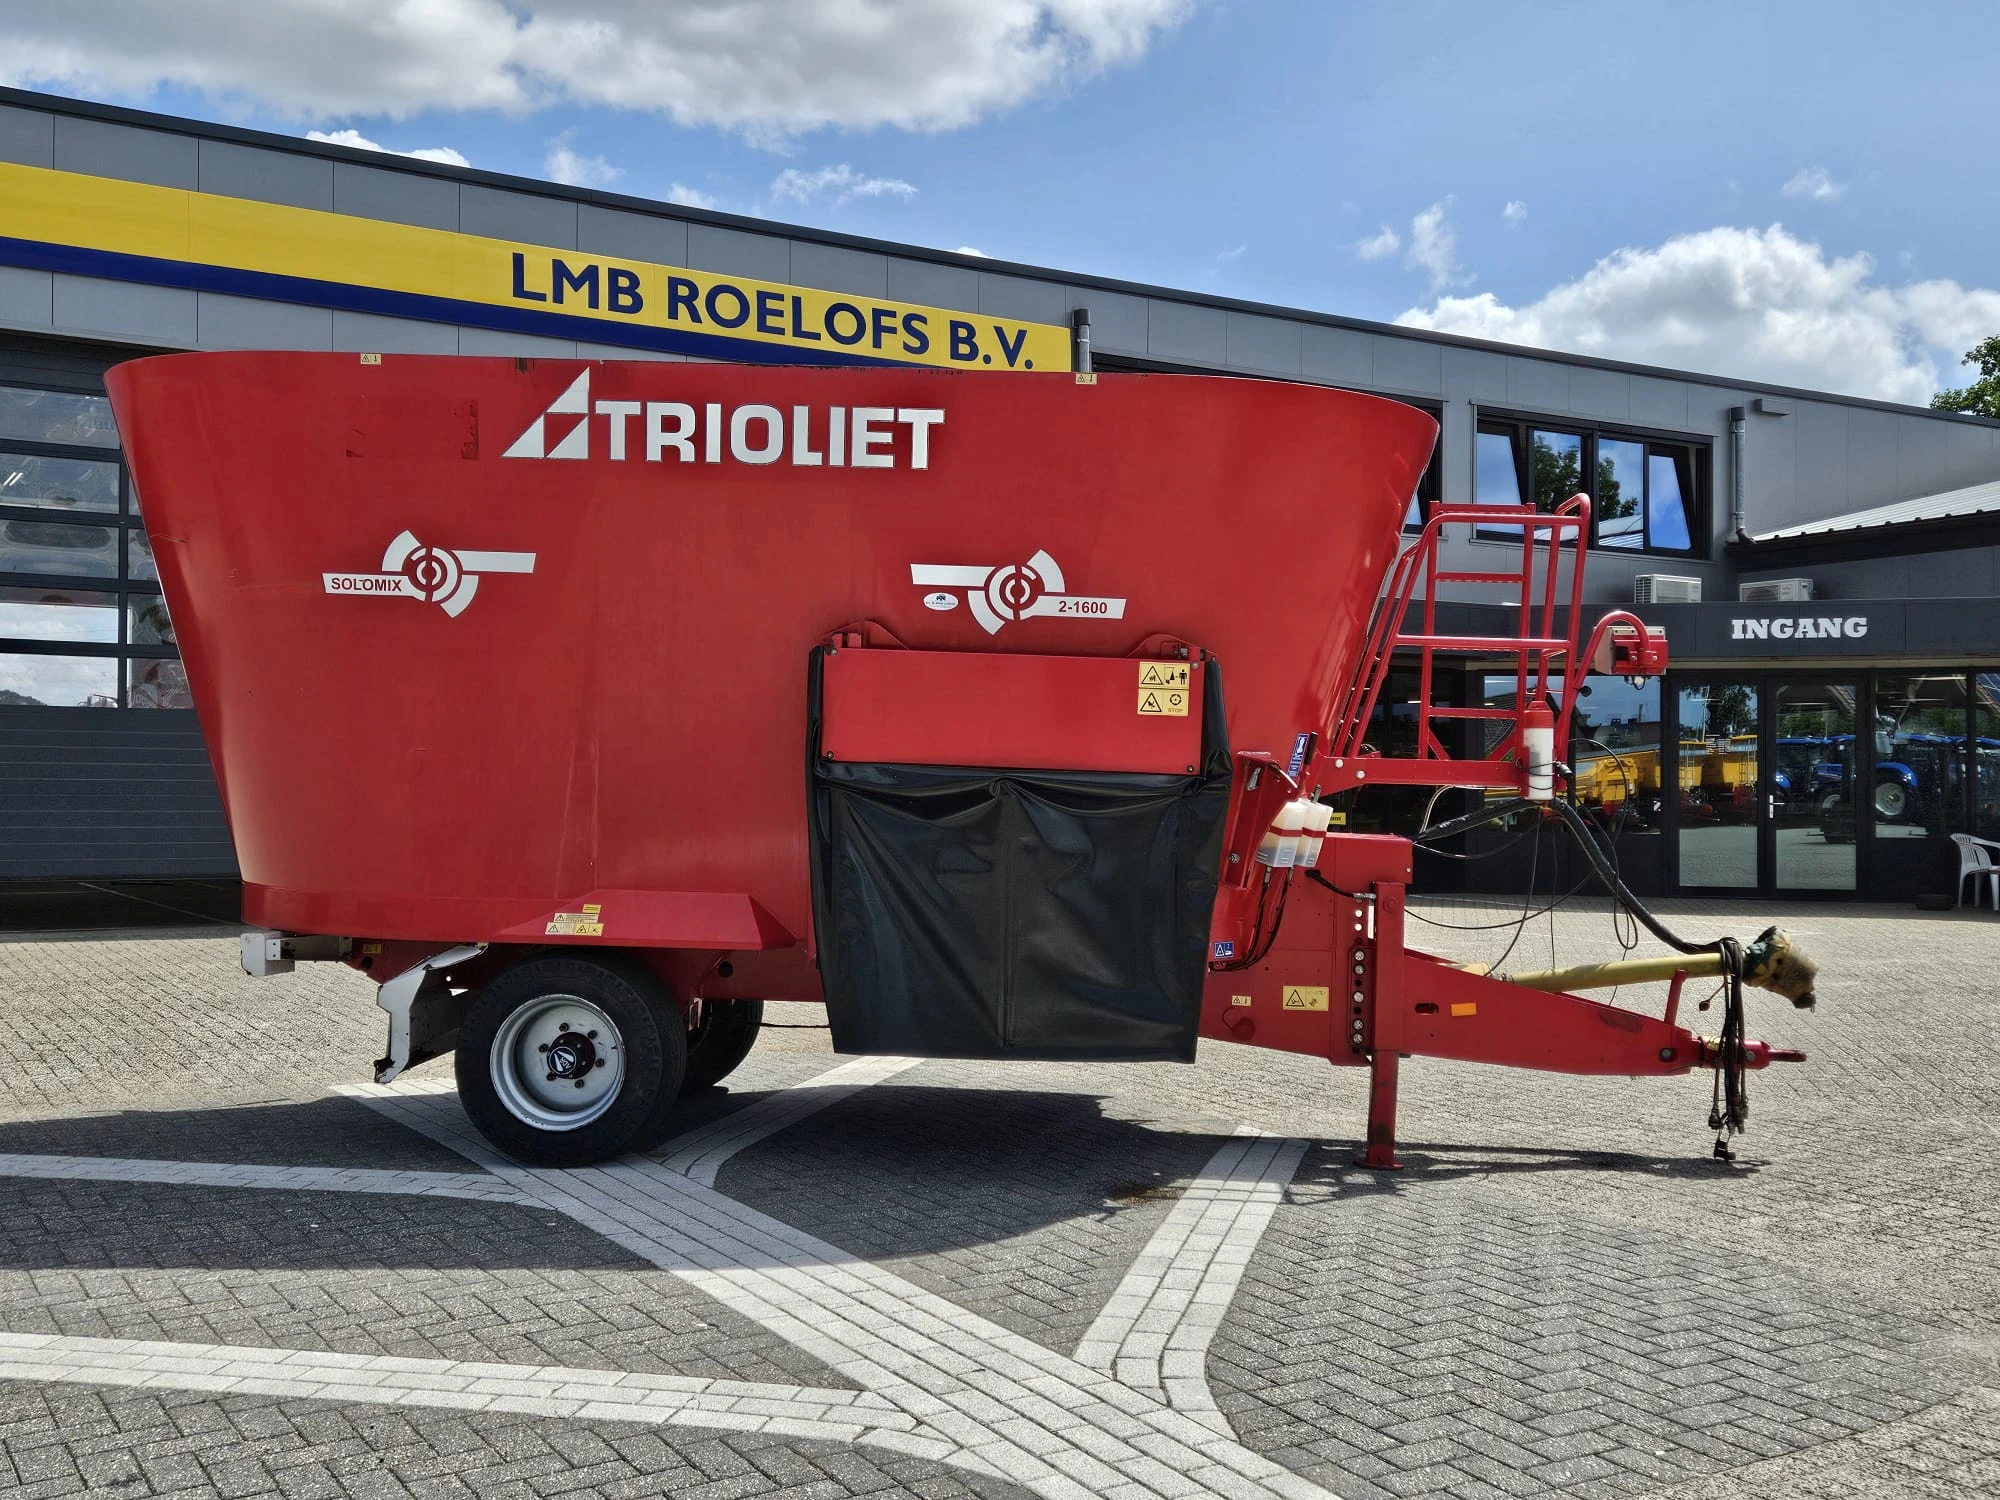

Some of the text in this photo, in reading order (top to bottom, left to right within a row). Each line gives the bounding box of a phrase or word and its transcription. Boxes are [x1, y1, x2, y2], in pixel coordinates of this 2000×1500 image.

[512, 252, 1034, 370] LMB ROELOFS B.V.
[595, 400, 945, 470] TRIOLIET
[331, 577, 402, 592] SOLOMIX
[1058, 600, 1108, 614] 2-1600
[1731, 617, 1868, 639] INGANG
